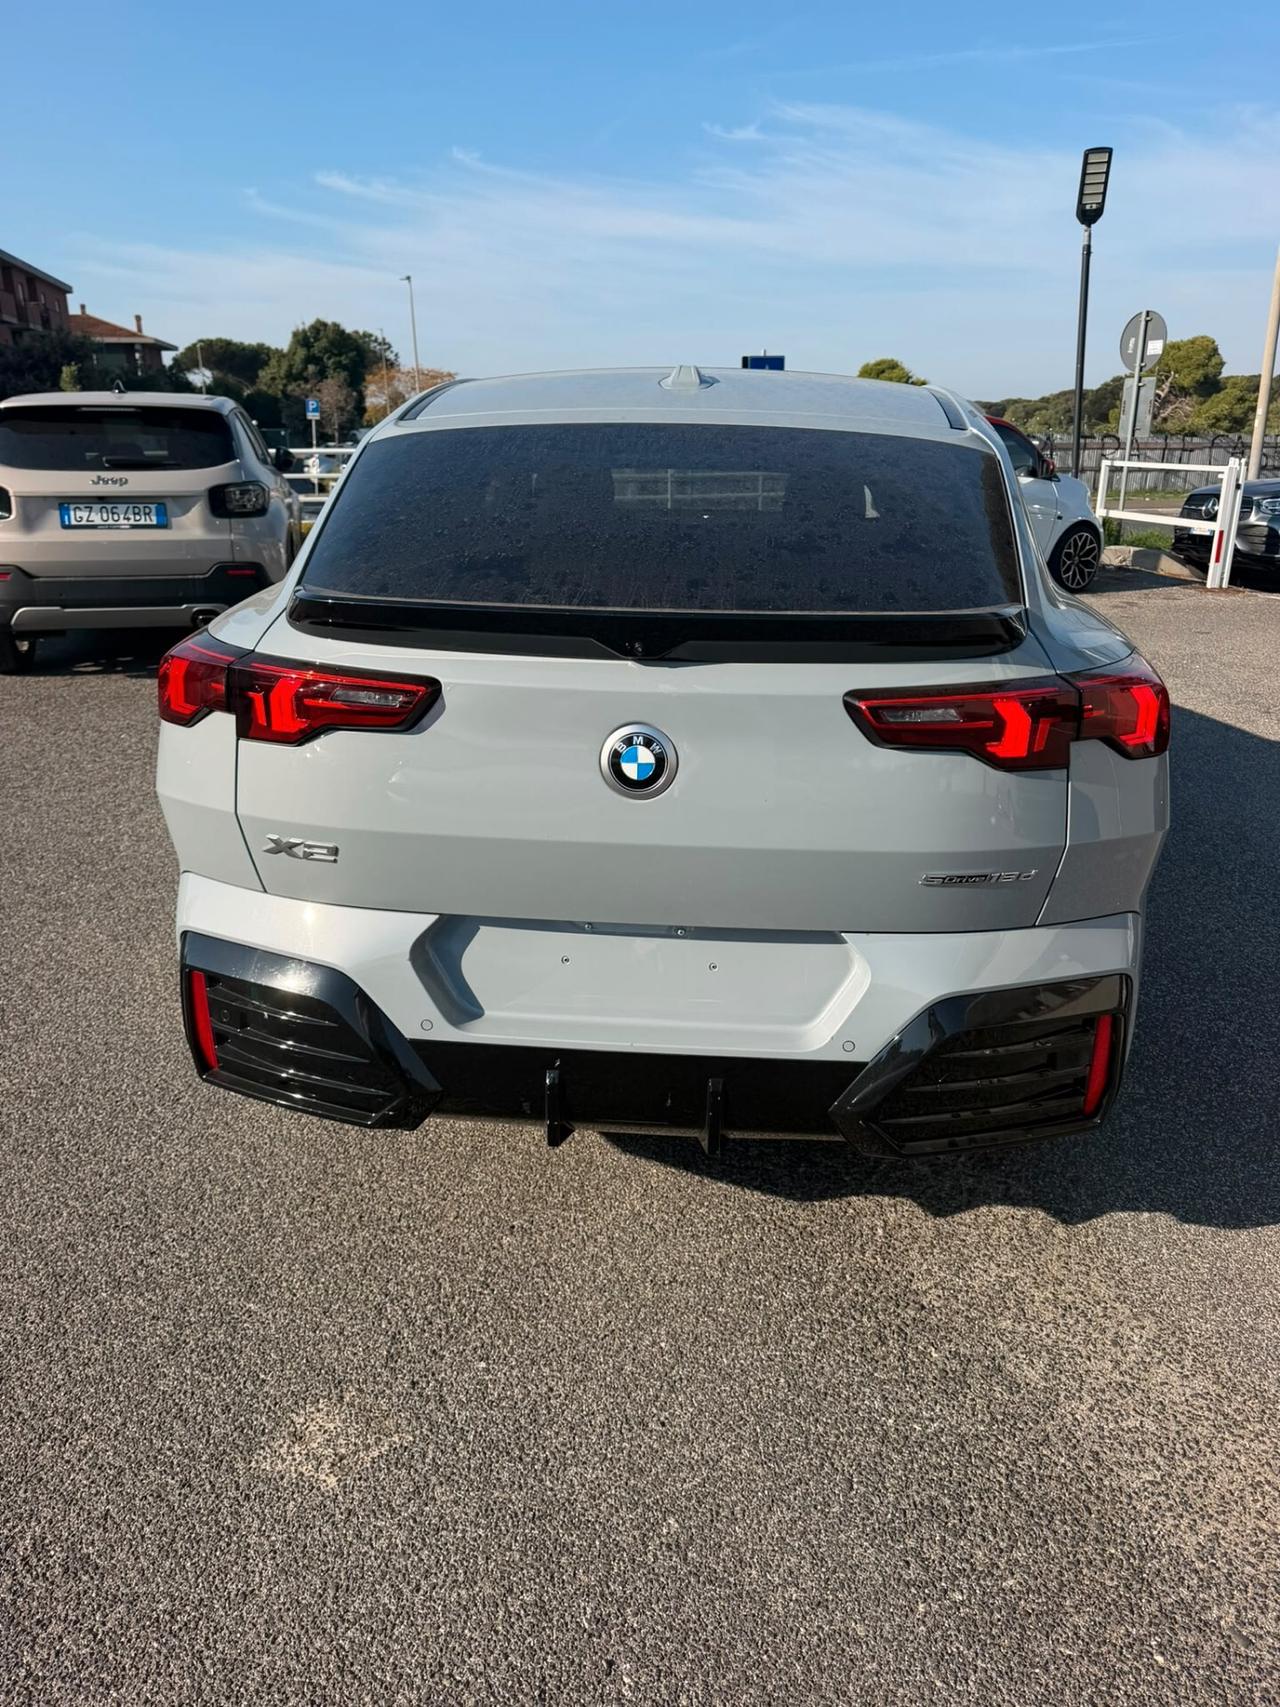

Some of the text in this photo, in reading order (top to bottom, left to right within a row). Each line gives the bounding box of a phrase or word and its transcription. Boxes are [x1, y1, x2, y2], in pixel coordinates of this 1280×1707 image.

[309, 400, 317, 412] P
[89, 475, 129, 487] Jeep
[73, 505, 153, 523] GZ 064BR
[615, 735, 662, 754] BMW
[262, 833, 339, 864] X2
